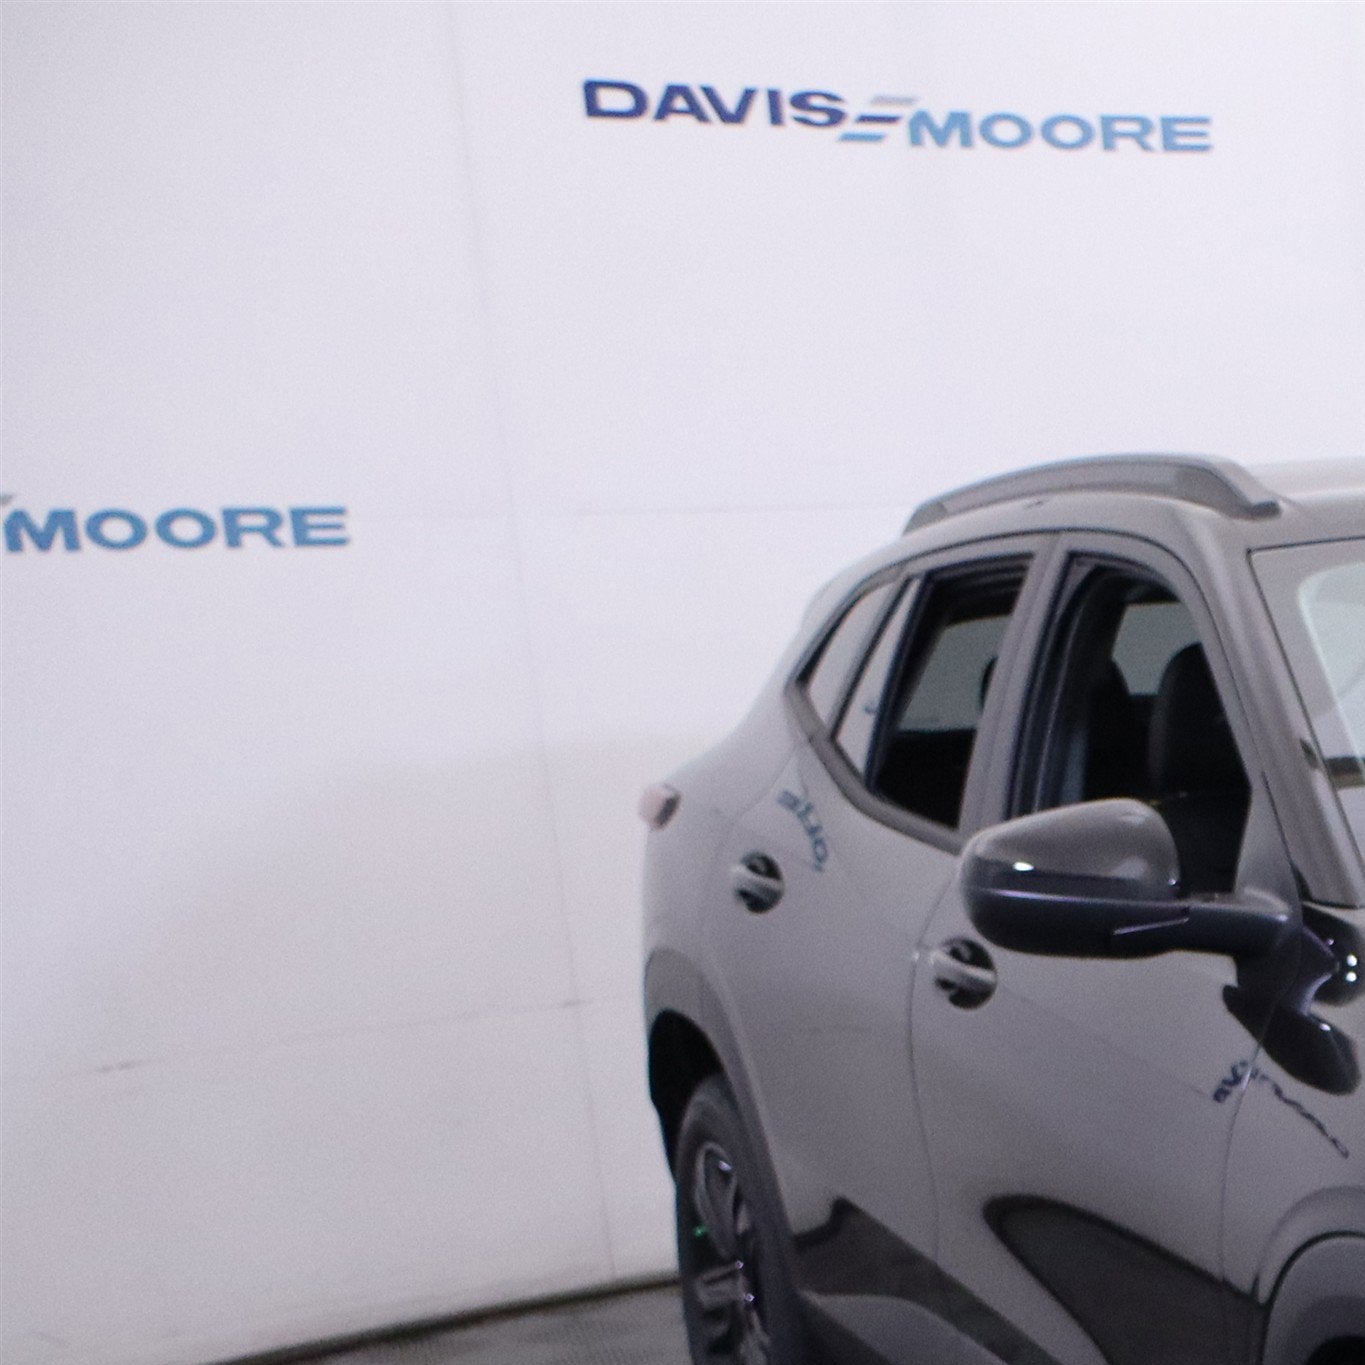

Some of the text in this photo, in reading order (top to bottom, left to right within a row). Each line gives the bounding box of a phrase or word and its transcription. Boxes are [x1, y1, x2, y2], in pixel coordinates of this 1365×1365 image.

[581, 78, 1213, 152] DAVIS MOORE
[2, 506, 348, 554] MOORE
